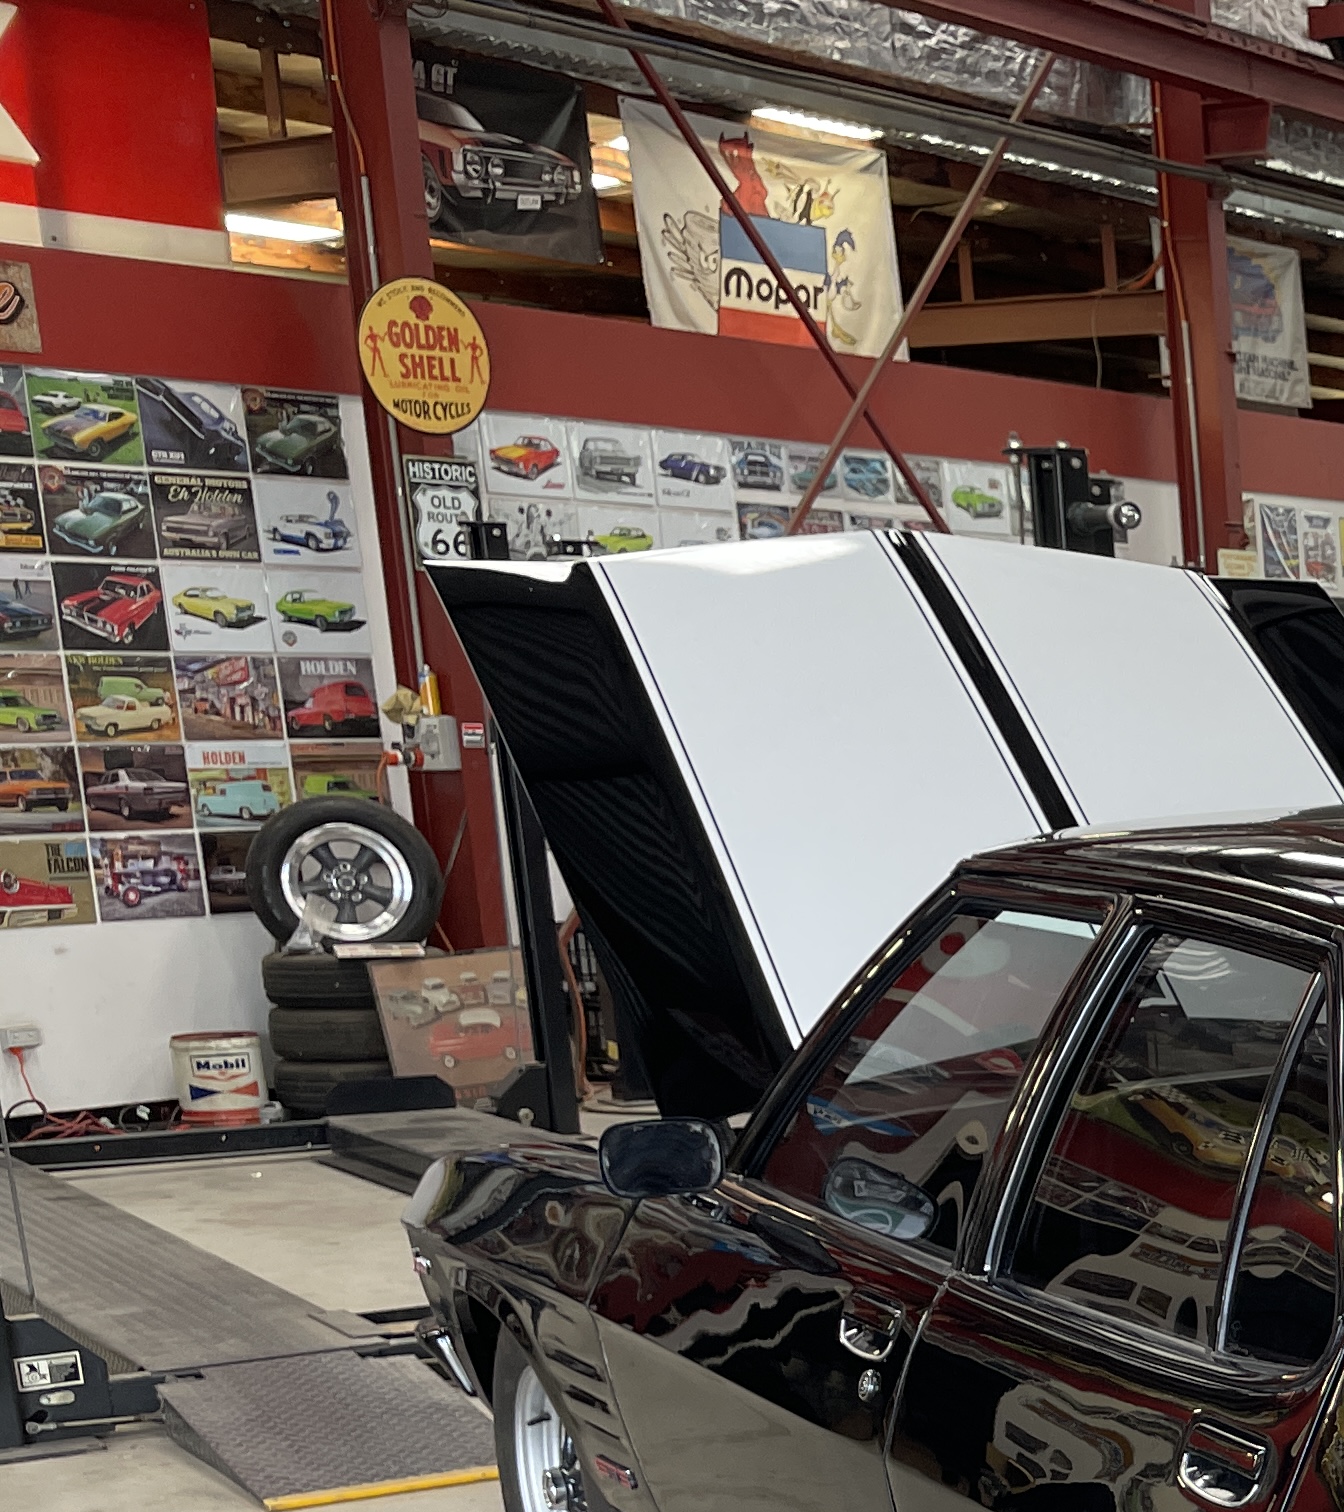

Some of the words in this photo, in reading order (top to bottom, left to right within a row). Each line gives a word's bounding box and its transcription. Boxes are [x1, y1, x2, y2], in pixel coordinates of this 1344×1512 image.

[387, 319, 461, 354] GOLDEN
[398, 353, 462, 383] SHELL
[408, 461, 477, 483] HISTORIC
[431, 495, 462, 510] OLD
[427, 511, 461, 524] ROUT
[431, 528, 468, 556] 66
[301, 659, 358, 676] HOLDEN
[202, 751, 246, 766] HOLDEN
[195, 1058, 246, 1070] Mobil
